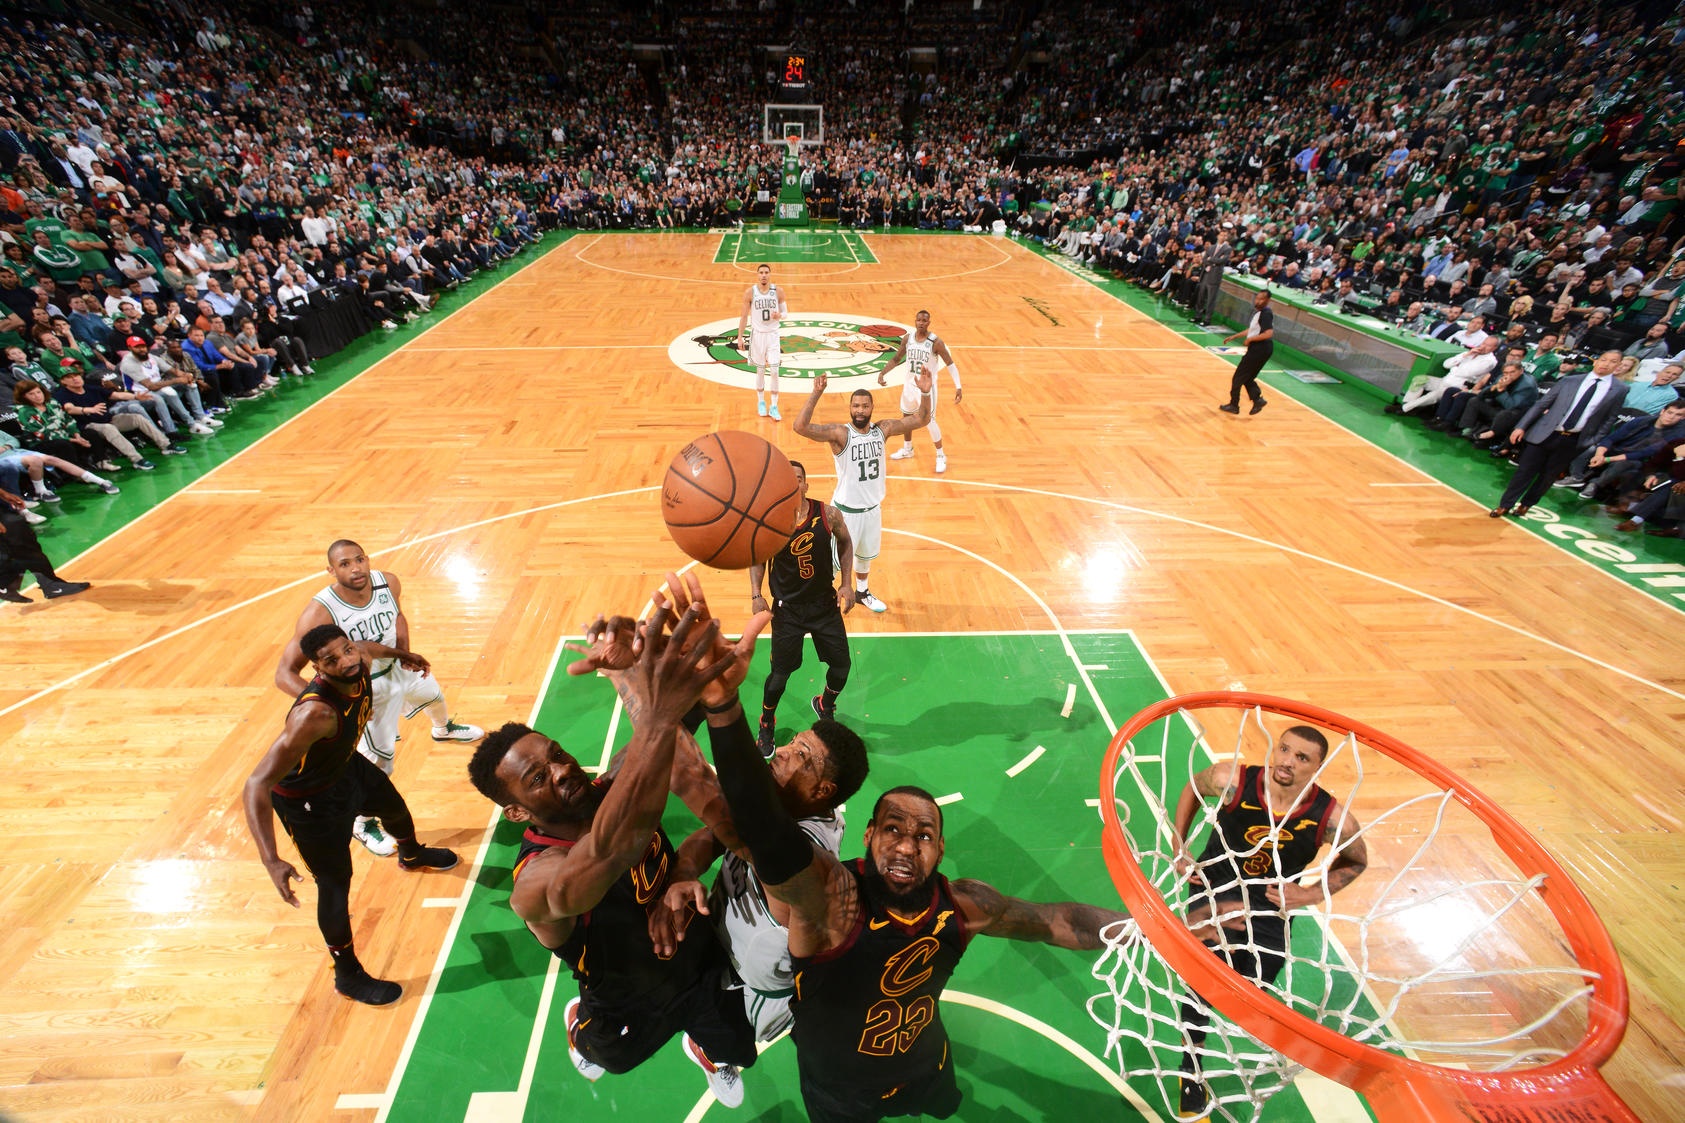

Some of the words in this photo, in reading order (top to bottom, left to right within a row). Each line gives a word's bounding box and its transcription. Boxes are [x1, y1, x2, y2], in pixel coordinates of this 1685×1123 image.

[788, 56, 805, 66] 2:34
[785, 65, 803, 81] 24
[1411, 171, 1426, 182] 13
[755, 298, 777, 310] CELTICS
[762, 309, 770, 321] 0
[781, 321, 857, 330] STON
[907, 348, 930, 363] CELTICS
[910, 360, 924, 375] 12
[851, 440, 883, 462] CELTICS
[857, 458, 880, 482] 13
[798, 555, 815, 580] 5
[348, 611, 394, 642] CELTICS
[1242, 850, 1273, 876] 3
[879, 935, 941, 998] C
[857, 994, 935, 1057] 23
